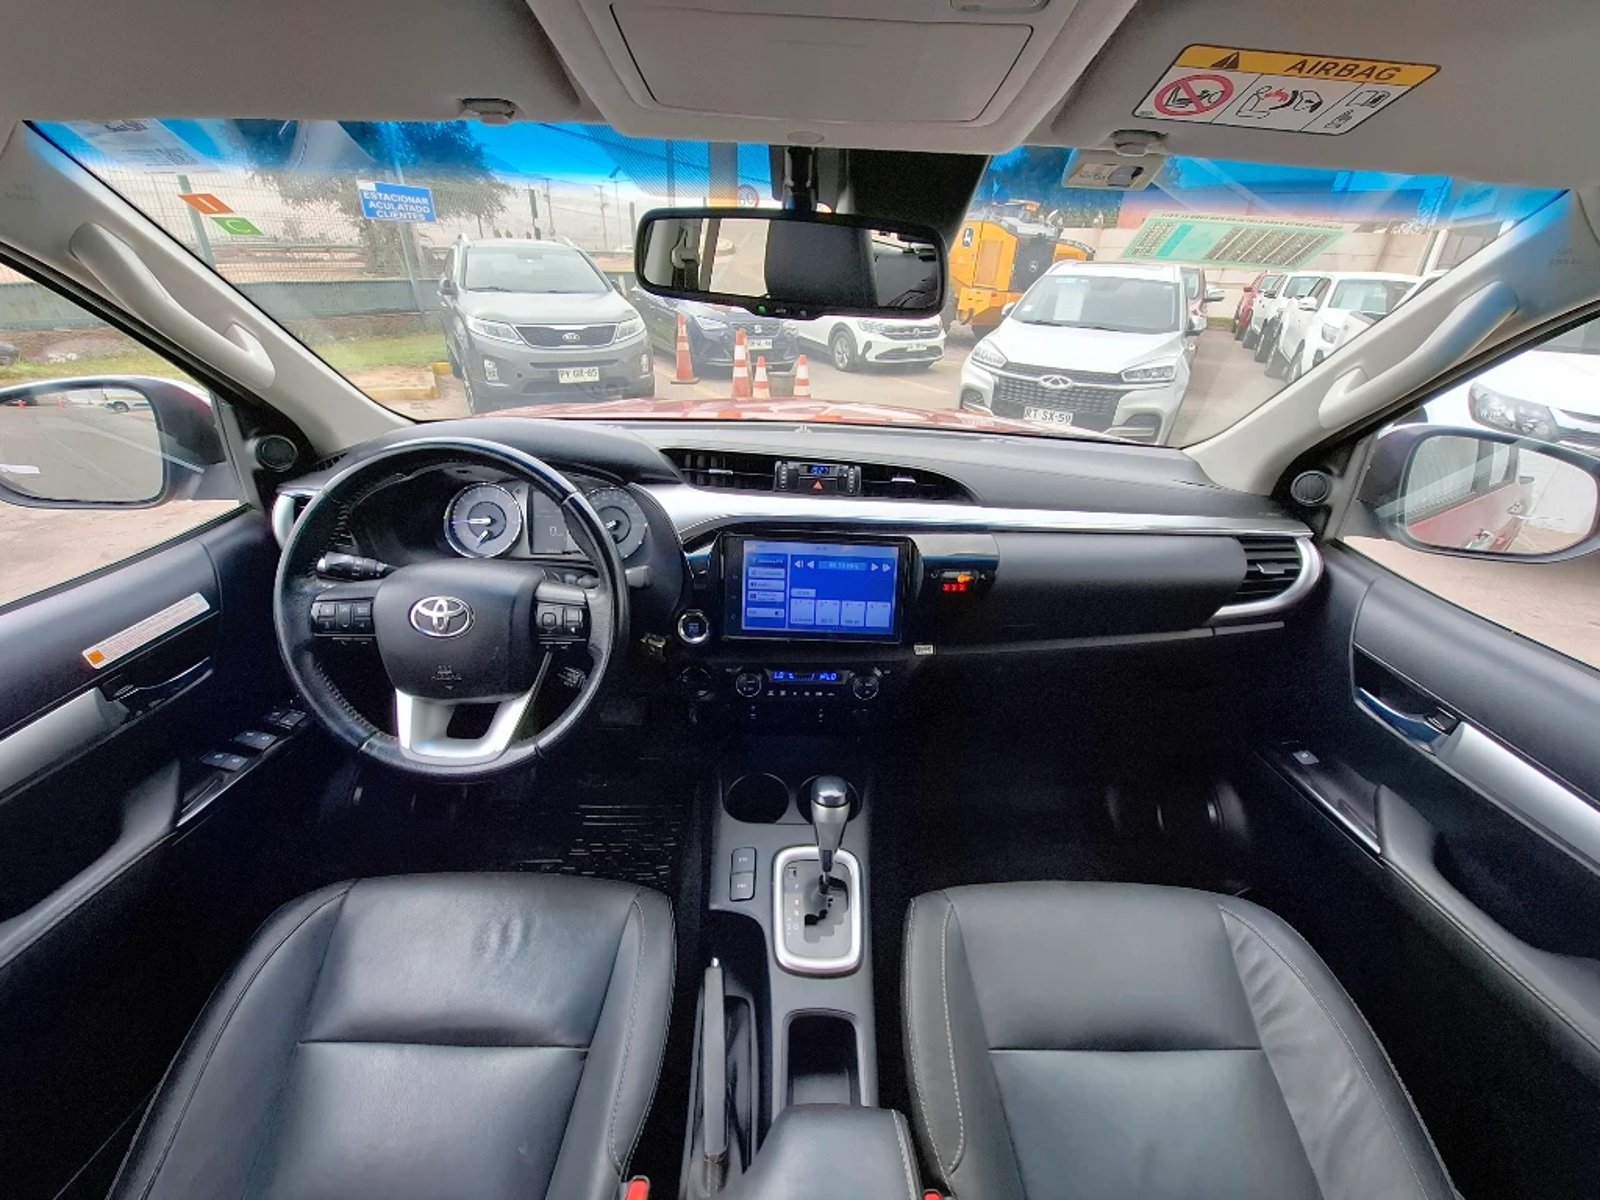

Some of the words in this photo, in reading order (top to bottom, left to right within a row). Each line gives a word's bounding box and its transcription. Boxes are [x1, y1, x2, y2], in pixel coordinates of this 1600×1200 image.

[1283, 58, 1402, 81] AIRBAG
[363, 191, 429, 205] ESTACIONAR
[369, 200, 431, 213] ACULATADO
[376, 210, 426, 221] CLIENTES
